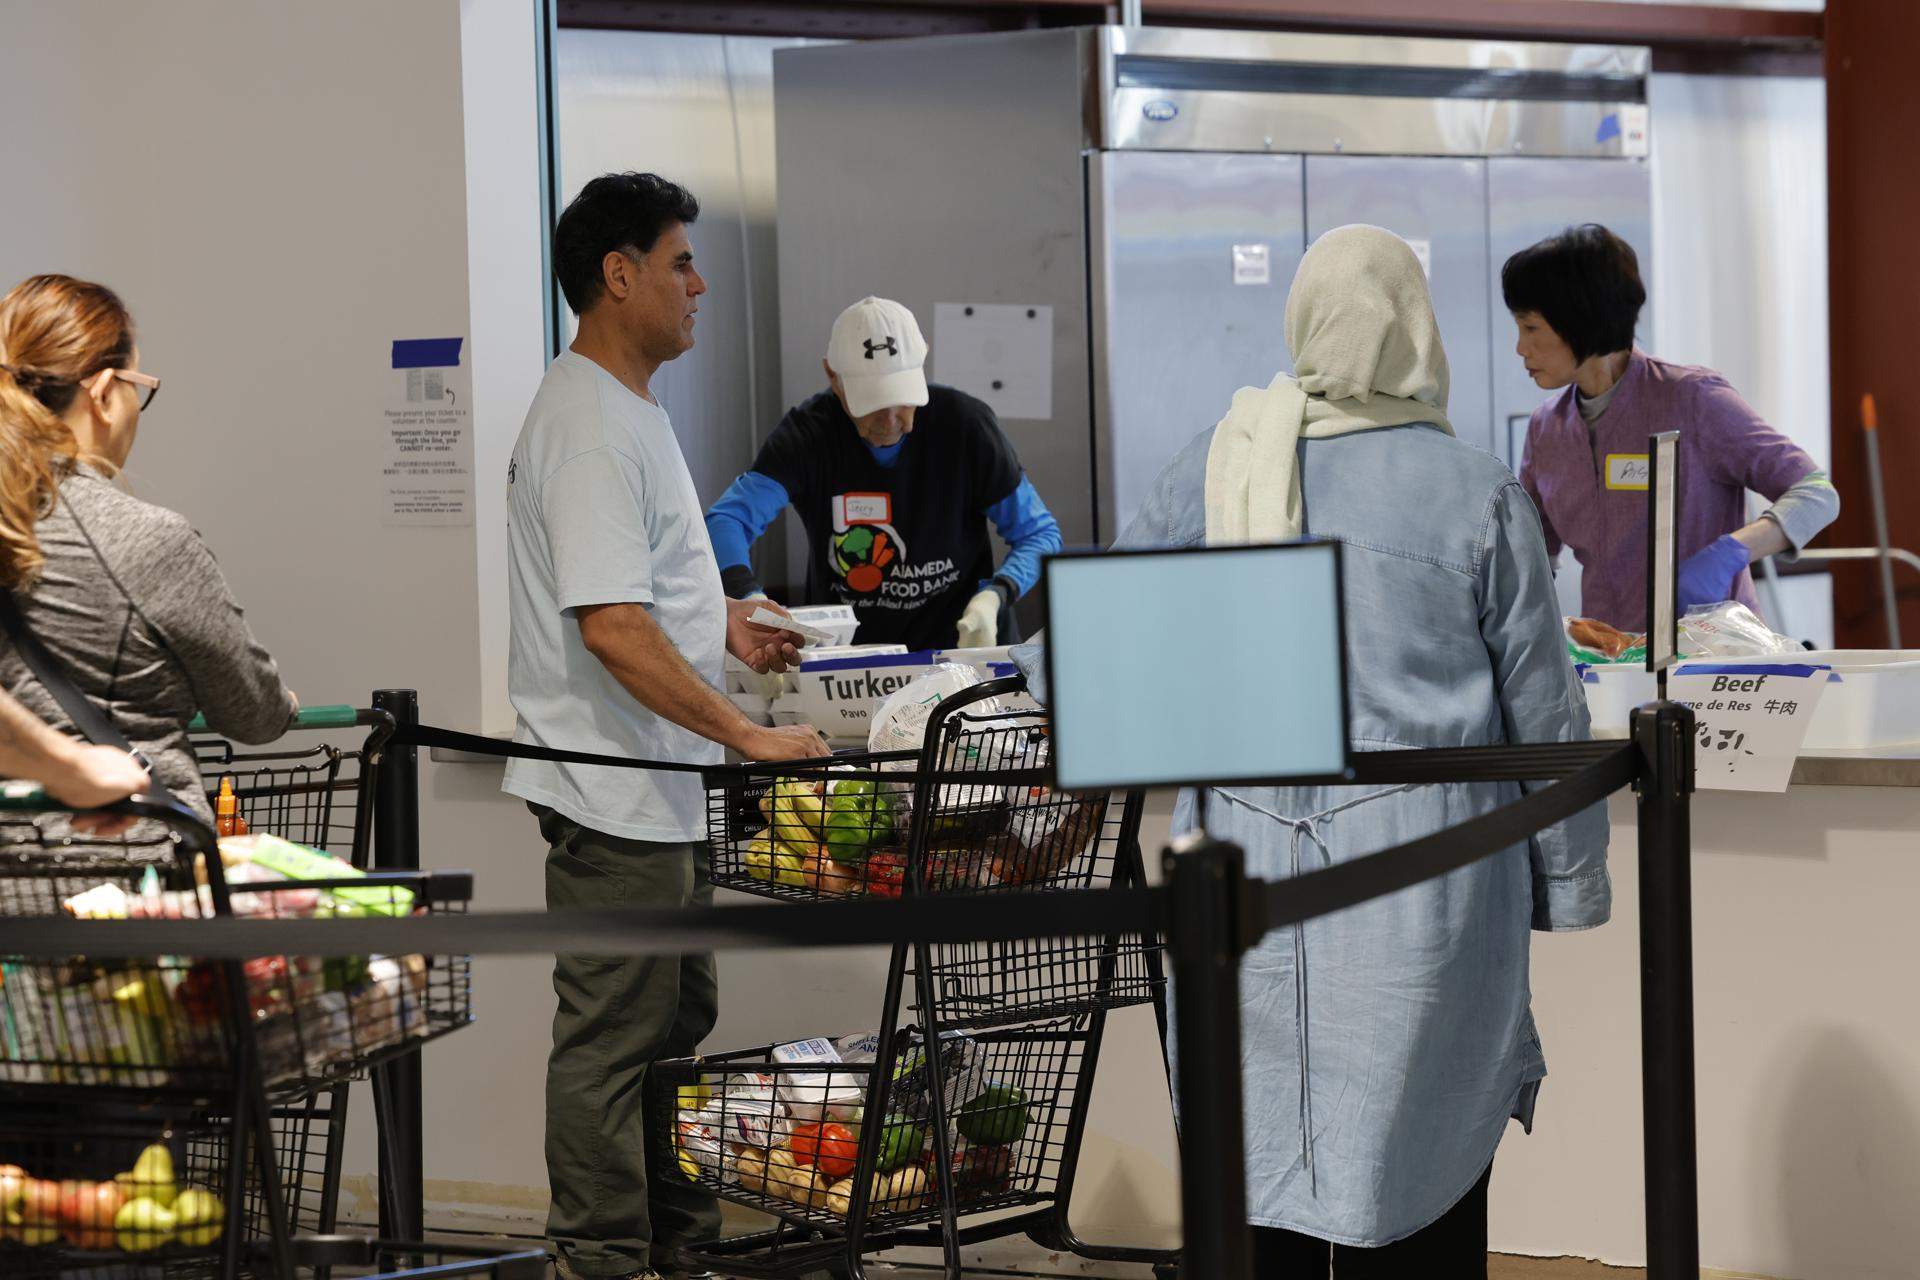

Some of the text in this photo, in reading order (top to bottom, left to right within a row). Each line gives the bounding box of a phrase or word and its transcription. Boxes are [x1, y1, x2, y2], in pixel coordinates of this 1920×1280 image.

[881, 581, 920, 597] FOOD
[923, 570, 960, 594] BANK
[1711, 675, 1768, 692] Beef
[1707, 700, 1724, 711] de
[1727, 701, 1752, 711] Res
[1763, 699, 1798, 715] 牛肉
[840, 709, 867, 719] Pavo
